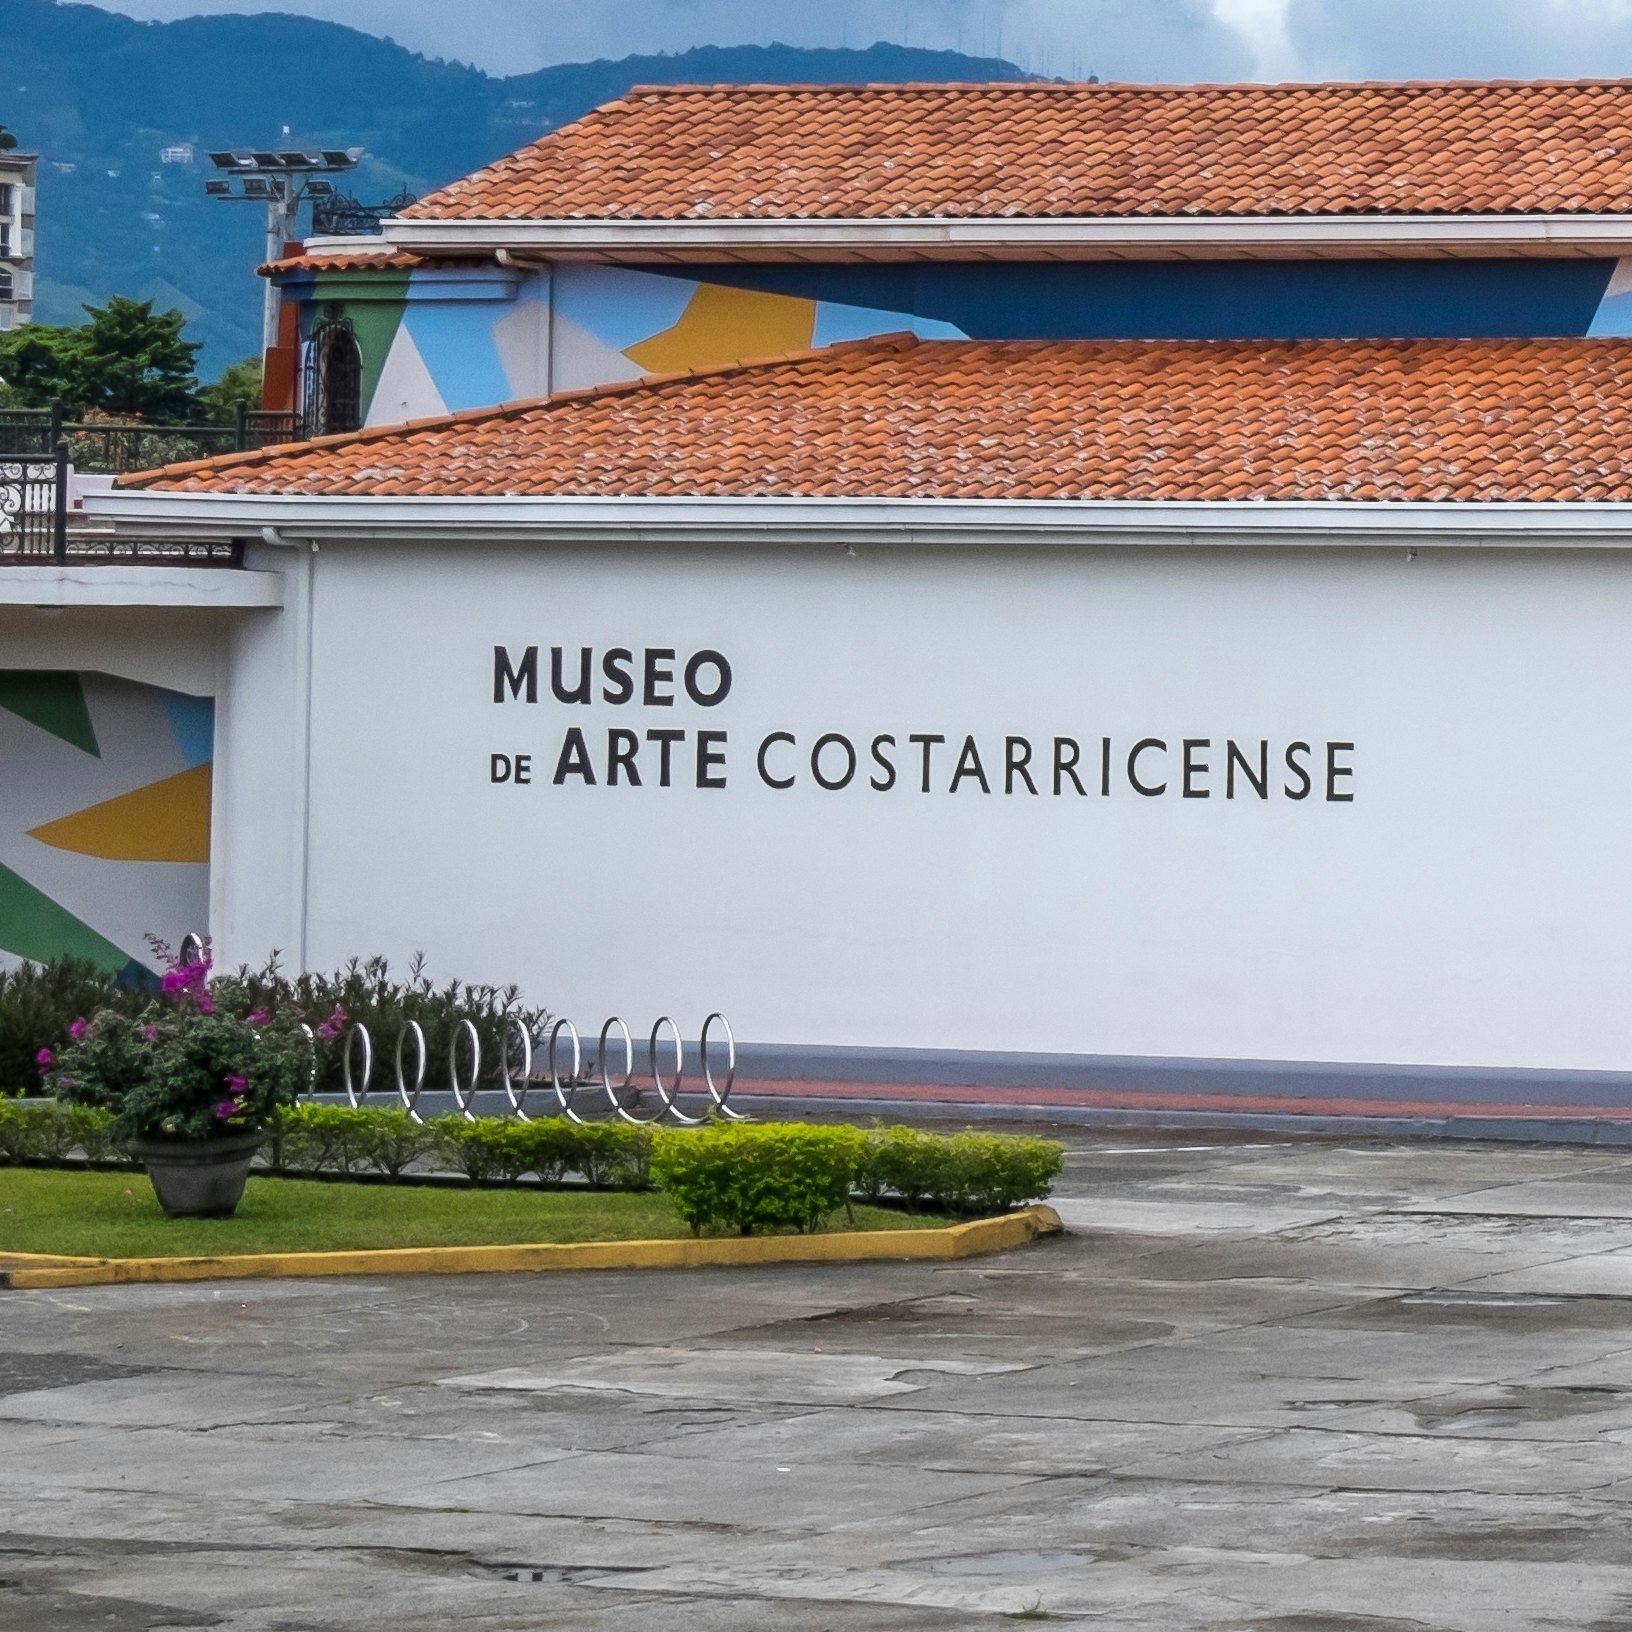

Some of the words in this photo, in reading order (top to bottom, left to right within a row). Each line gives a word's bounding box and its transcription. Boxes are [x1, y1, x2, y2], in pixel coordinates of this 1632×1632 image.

[493, 645, 733, 708] MUSEO
[490, 753, 532, 785] DE
[552, 727, 728, 789] ARTE
[756, 731, 1355, 802] COSTARRICENSE
